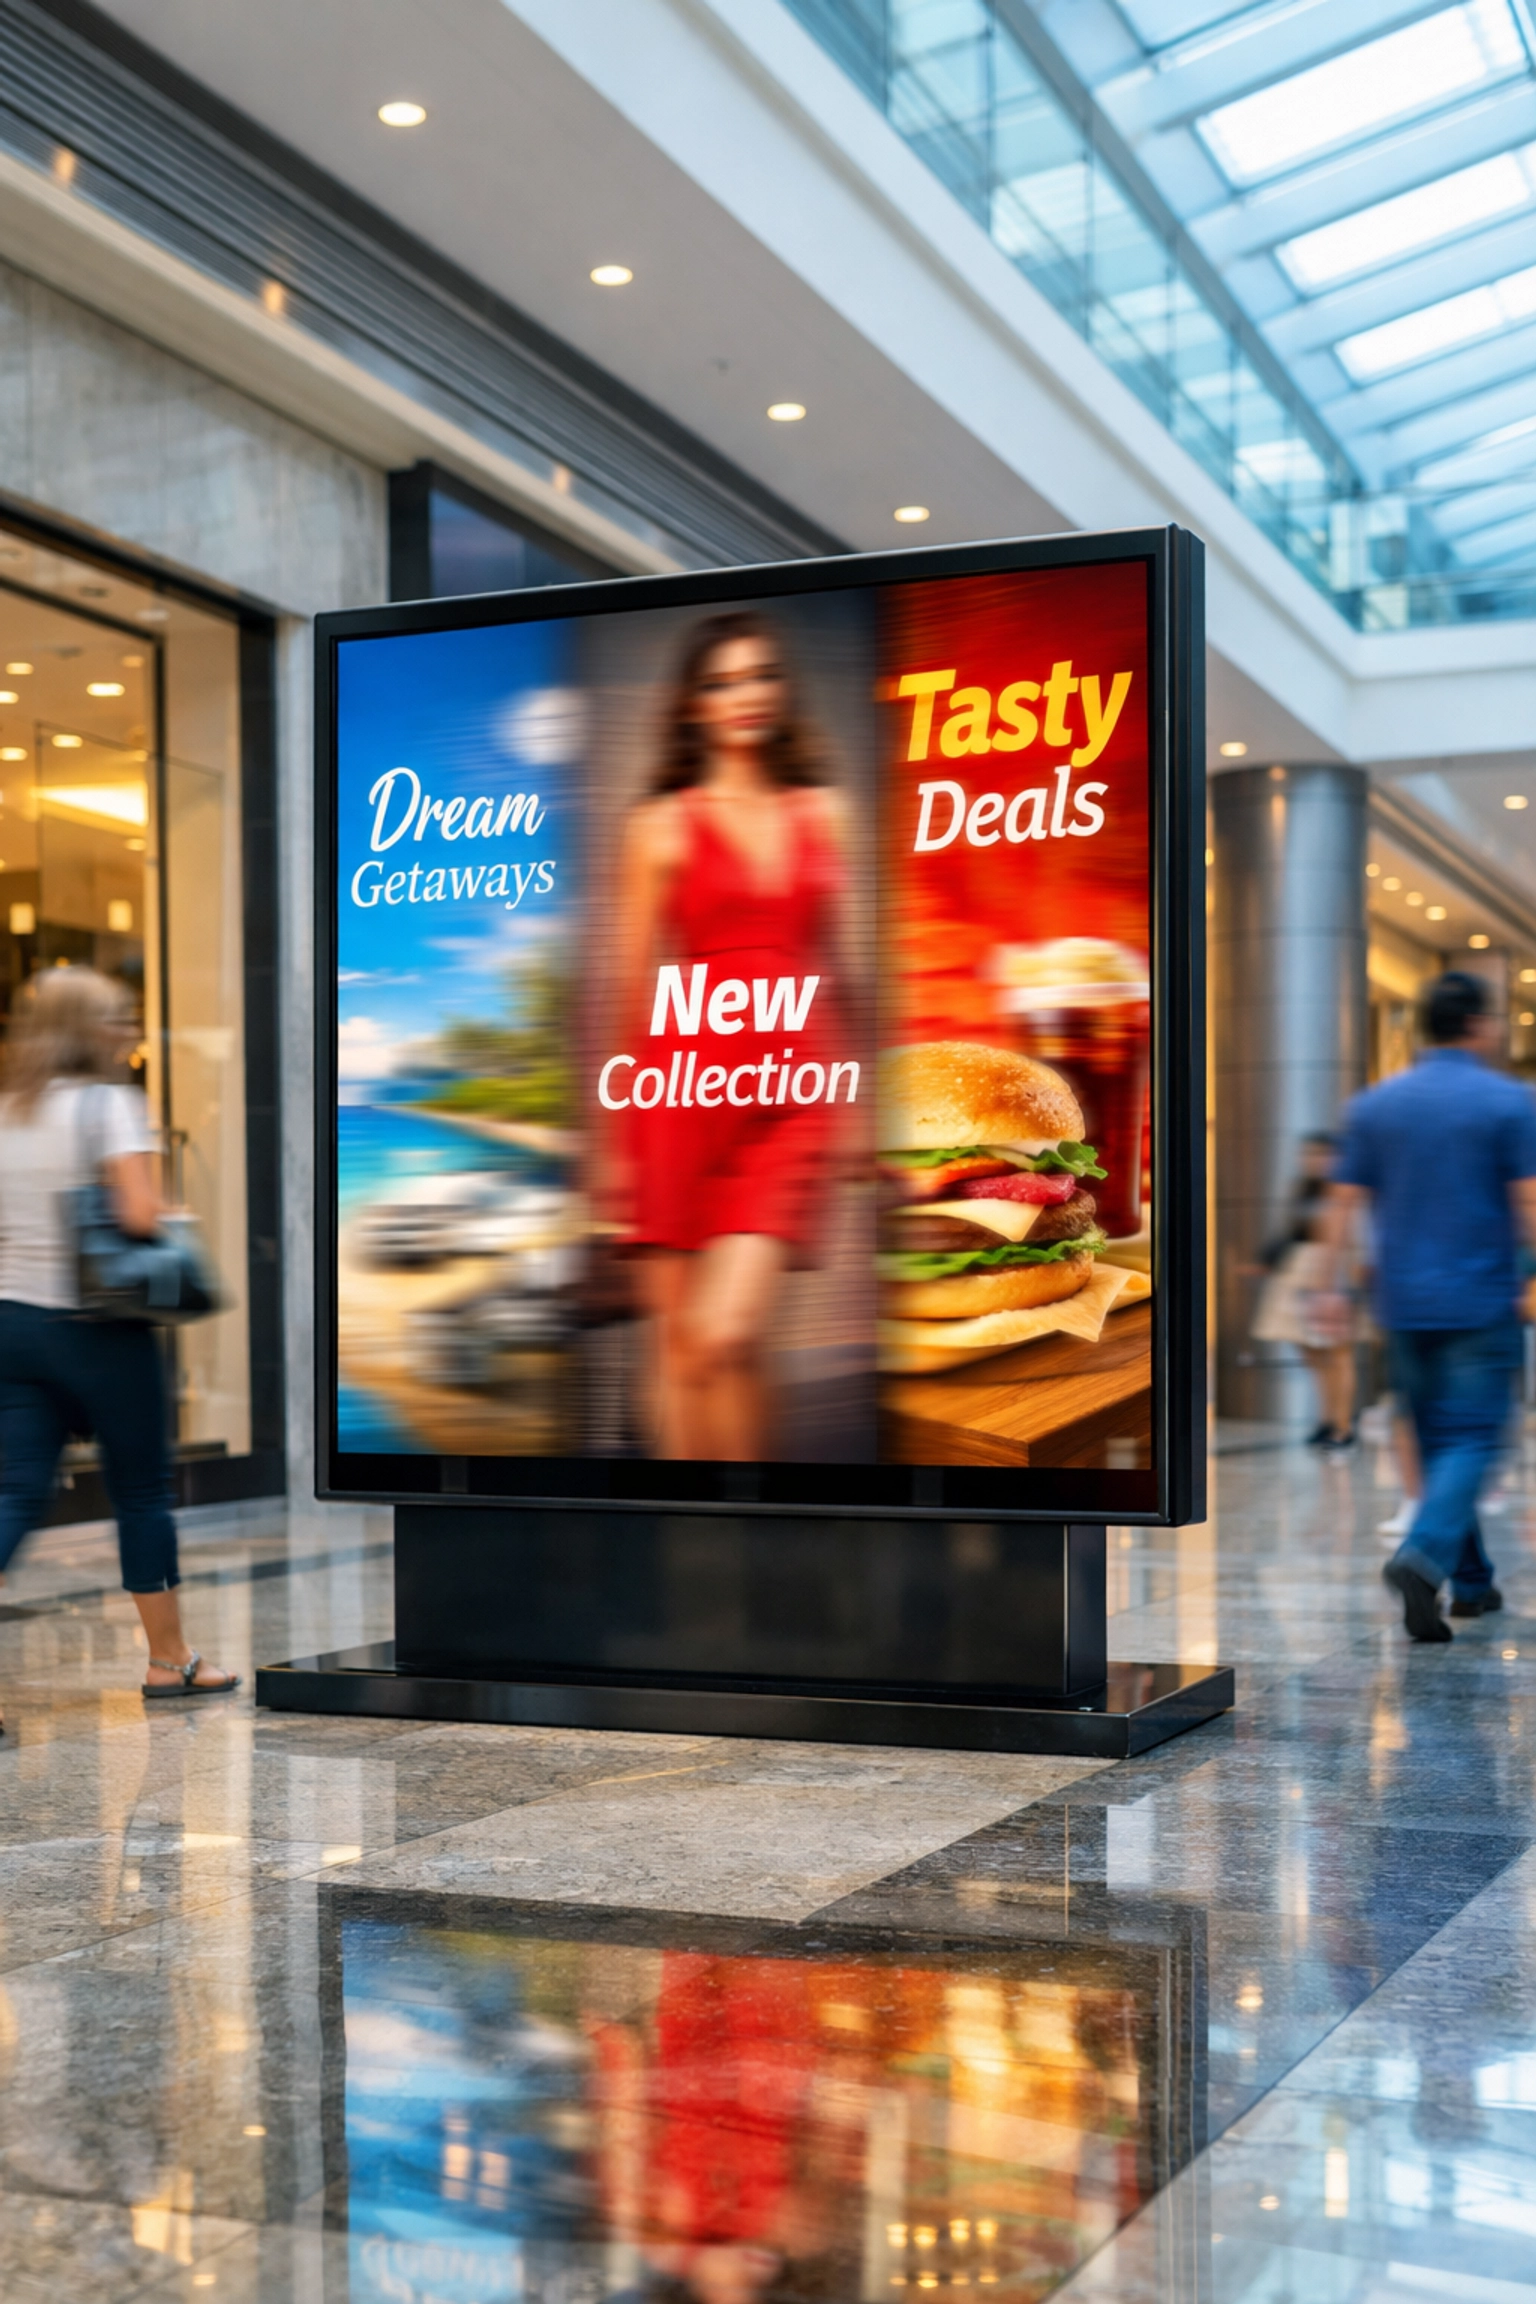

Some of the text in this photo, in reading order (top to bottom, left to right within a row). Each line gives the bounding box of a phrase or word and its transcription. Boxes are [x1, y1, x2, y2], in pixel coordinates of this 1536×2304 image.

[897, 660, 1133, 768] Tasty
[368, 767, 547, 852] Dream
[913, 764, 1109, 852] Deals
[351, 860, 557, 910] Getaways
[650, 963, 820, 1037] New
[597, 1048, 861, 1111] Collection
